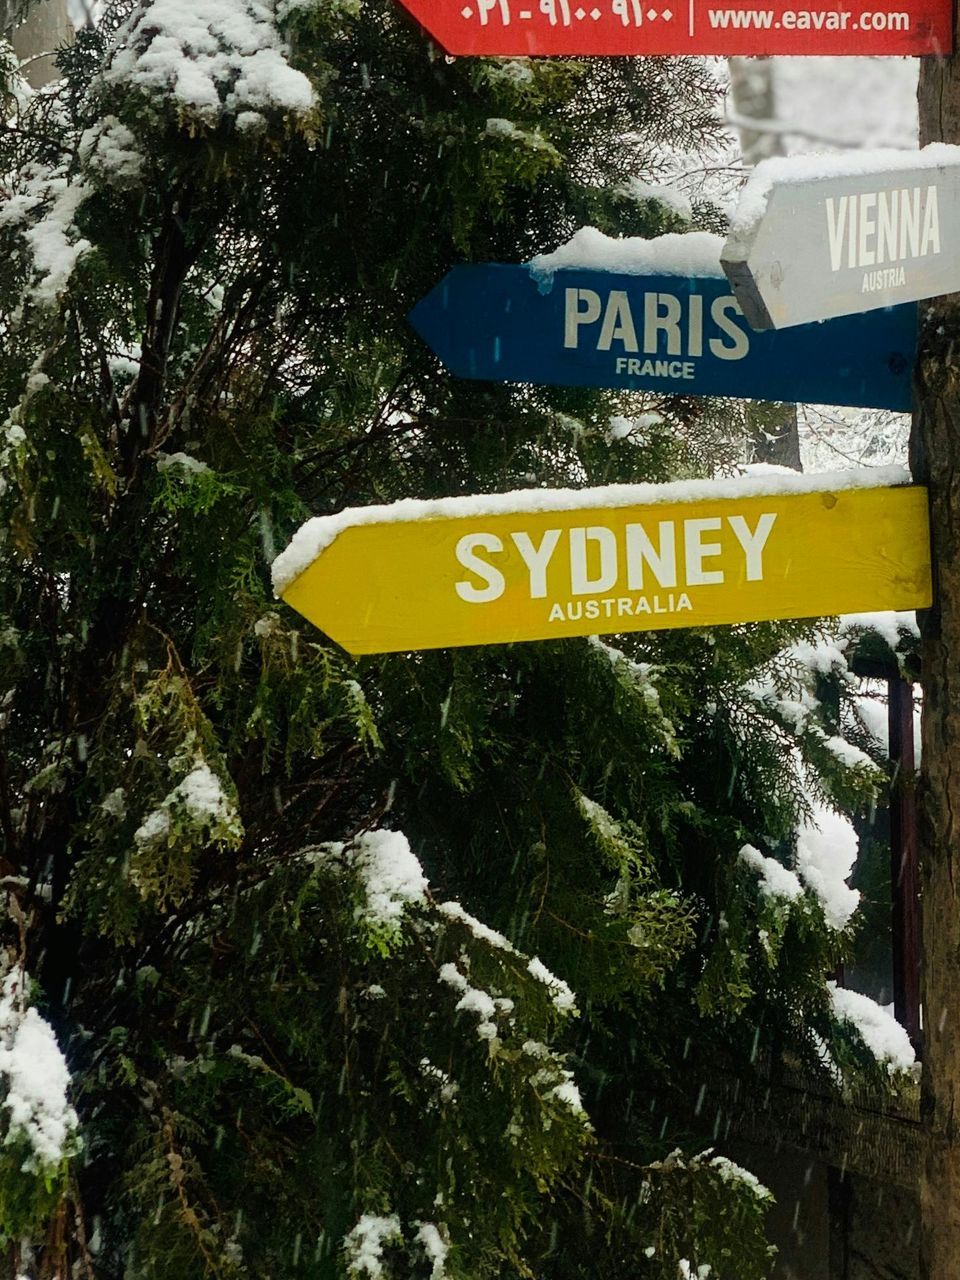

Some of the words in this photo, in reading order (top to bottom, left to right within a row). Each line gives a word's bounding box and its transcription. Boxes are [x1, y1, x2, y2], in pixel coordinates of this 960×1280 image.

[708, 9, 910, 31] www.eavar.com
[825, 185, 941, 272] VIENNA
[861, 267, 906, 294] AUSTRIA
[564, 287, 749, 361] PARIS
[615, 357, 695, 380] FRANCE
[455, 513, 777, 604] SYDNEY
[548, 593, 693, 622] AUSTRALIA
